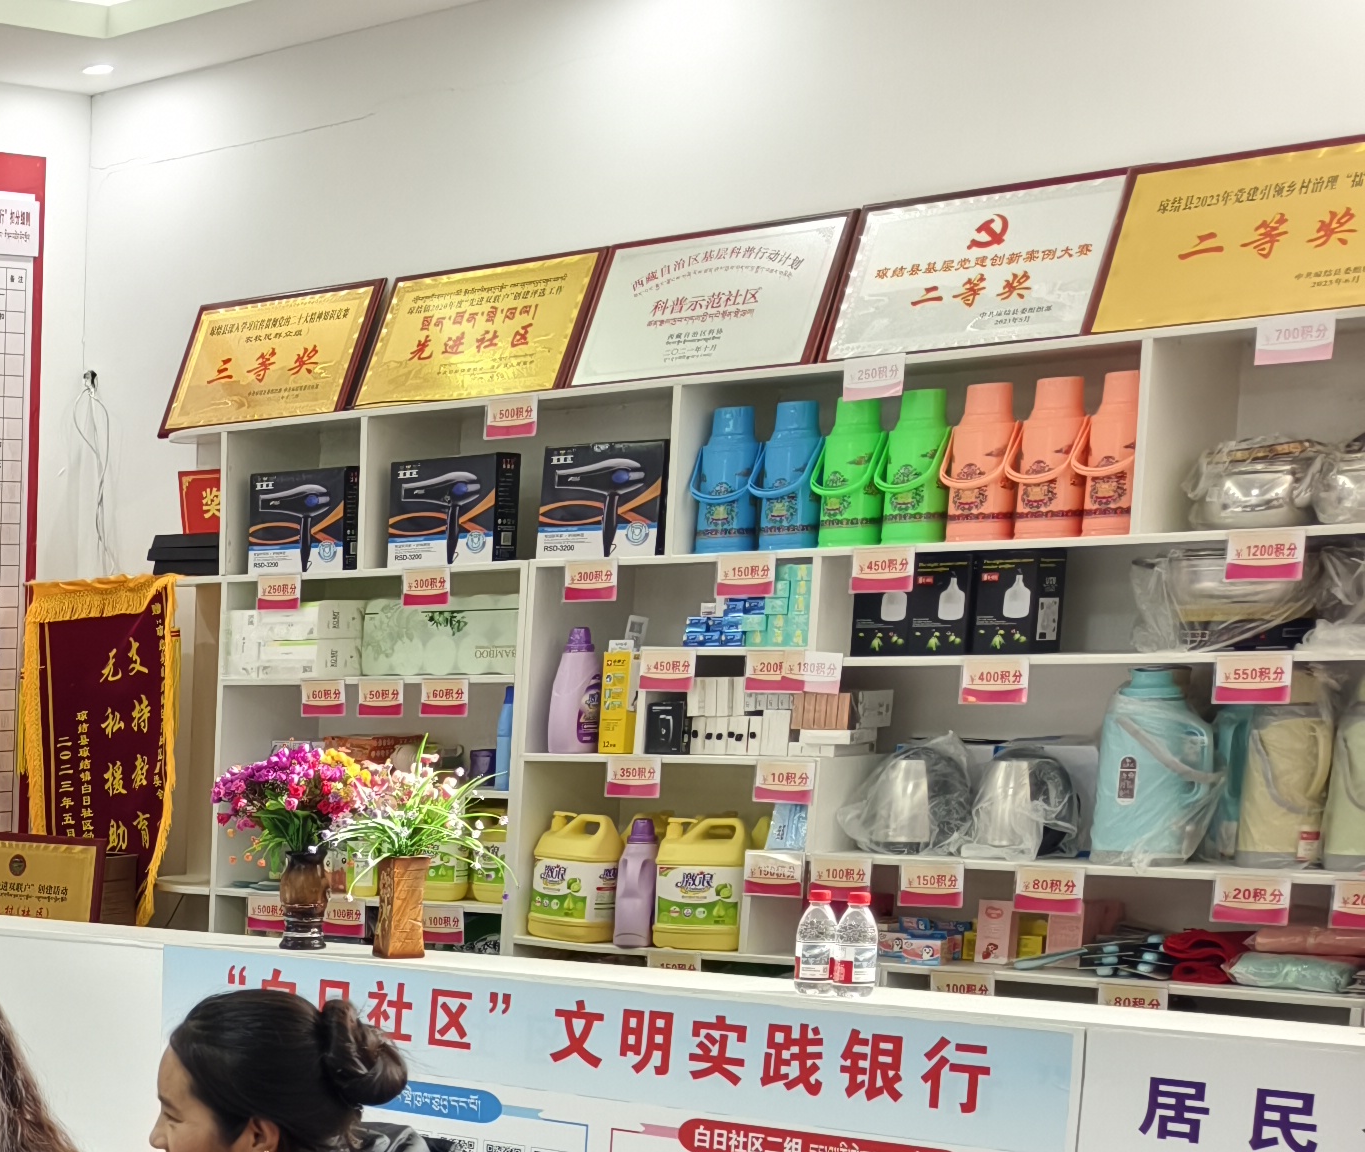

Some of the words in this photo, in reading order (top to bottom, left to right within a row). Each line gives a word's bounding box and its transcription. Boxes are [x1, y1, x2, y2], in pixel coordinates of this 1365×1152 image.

[1178, 207, 1358, 260] 二等奖
[631, 246, 805, 292] 西藏自治区基层科普行动计划
[875, 243, 1093, 279] 琼结县基层党建创新案例大赛
[650, 287, 762, 317] 科普示范社区
[910, 270, 1032, 308] 二等奖
[408, 323, 534, 362] 先进社区
[206, 344, 319, 384] 三等奖
[394, 553, 423, 561] RSD-3200
[543, 544, 575, 552] RSD-3200
[551, 999, 992, 1116] 文明实践银行
